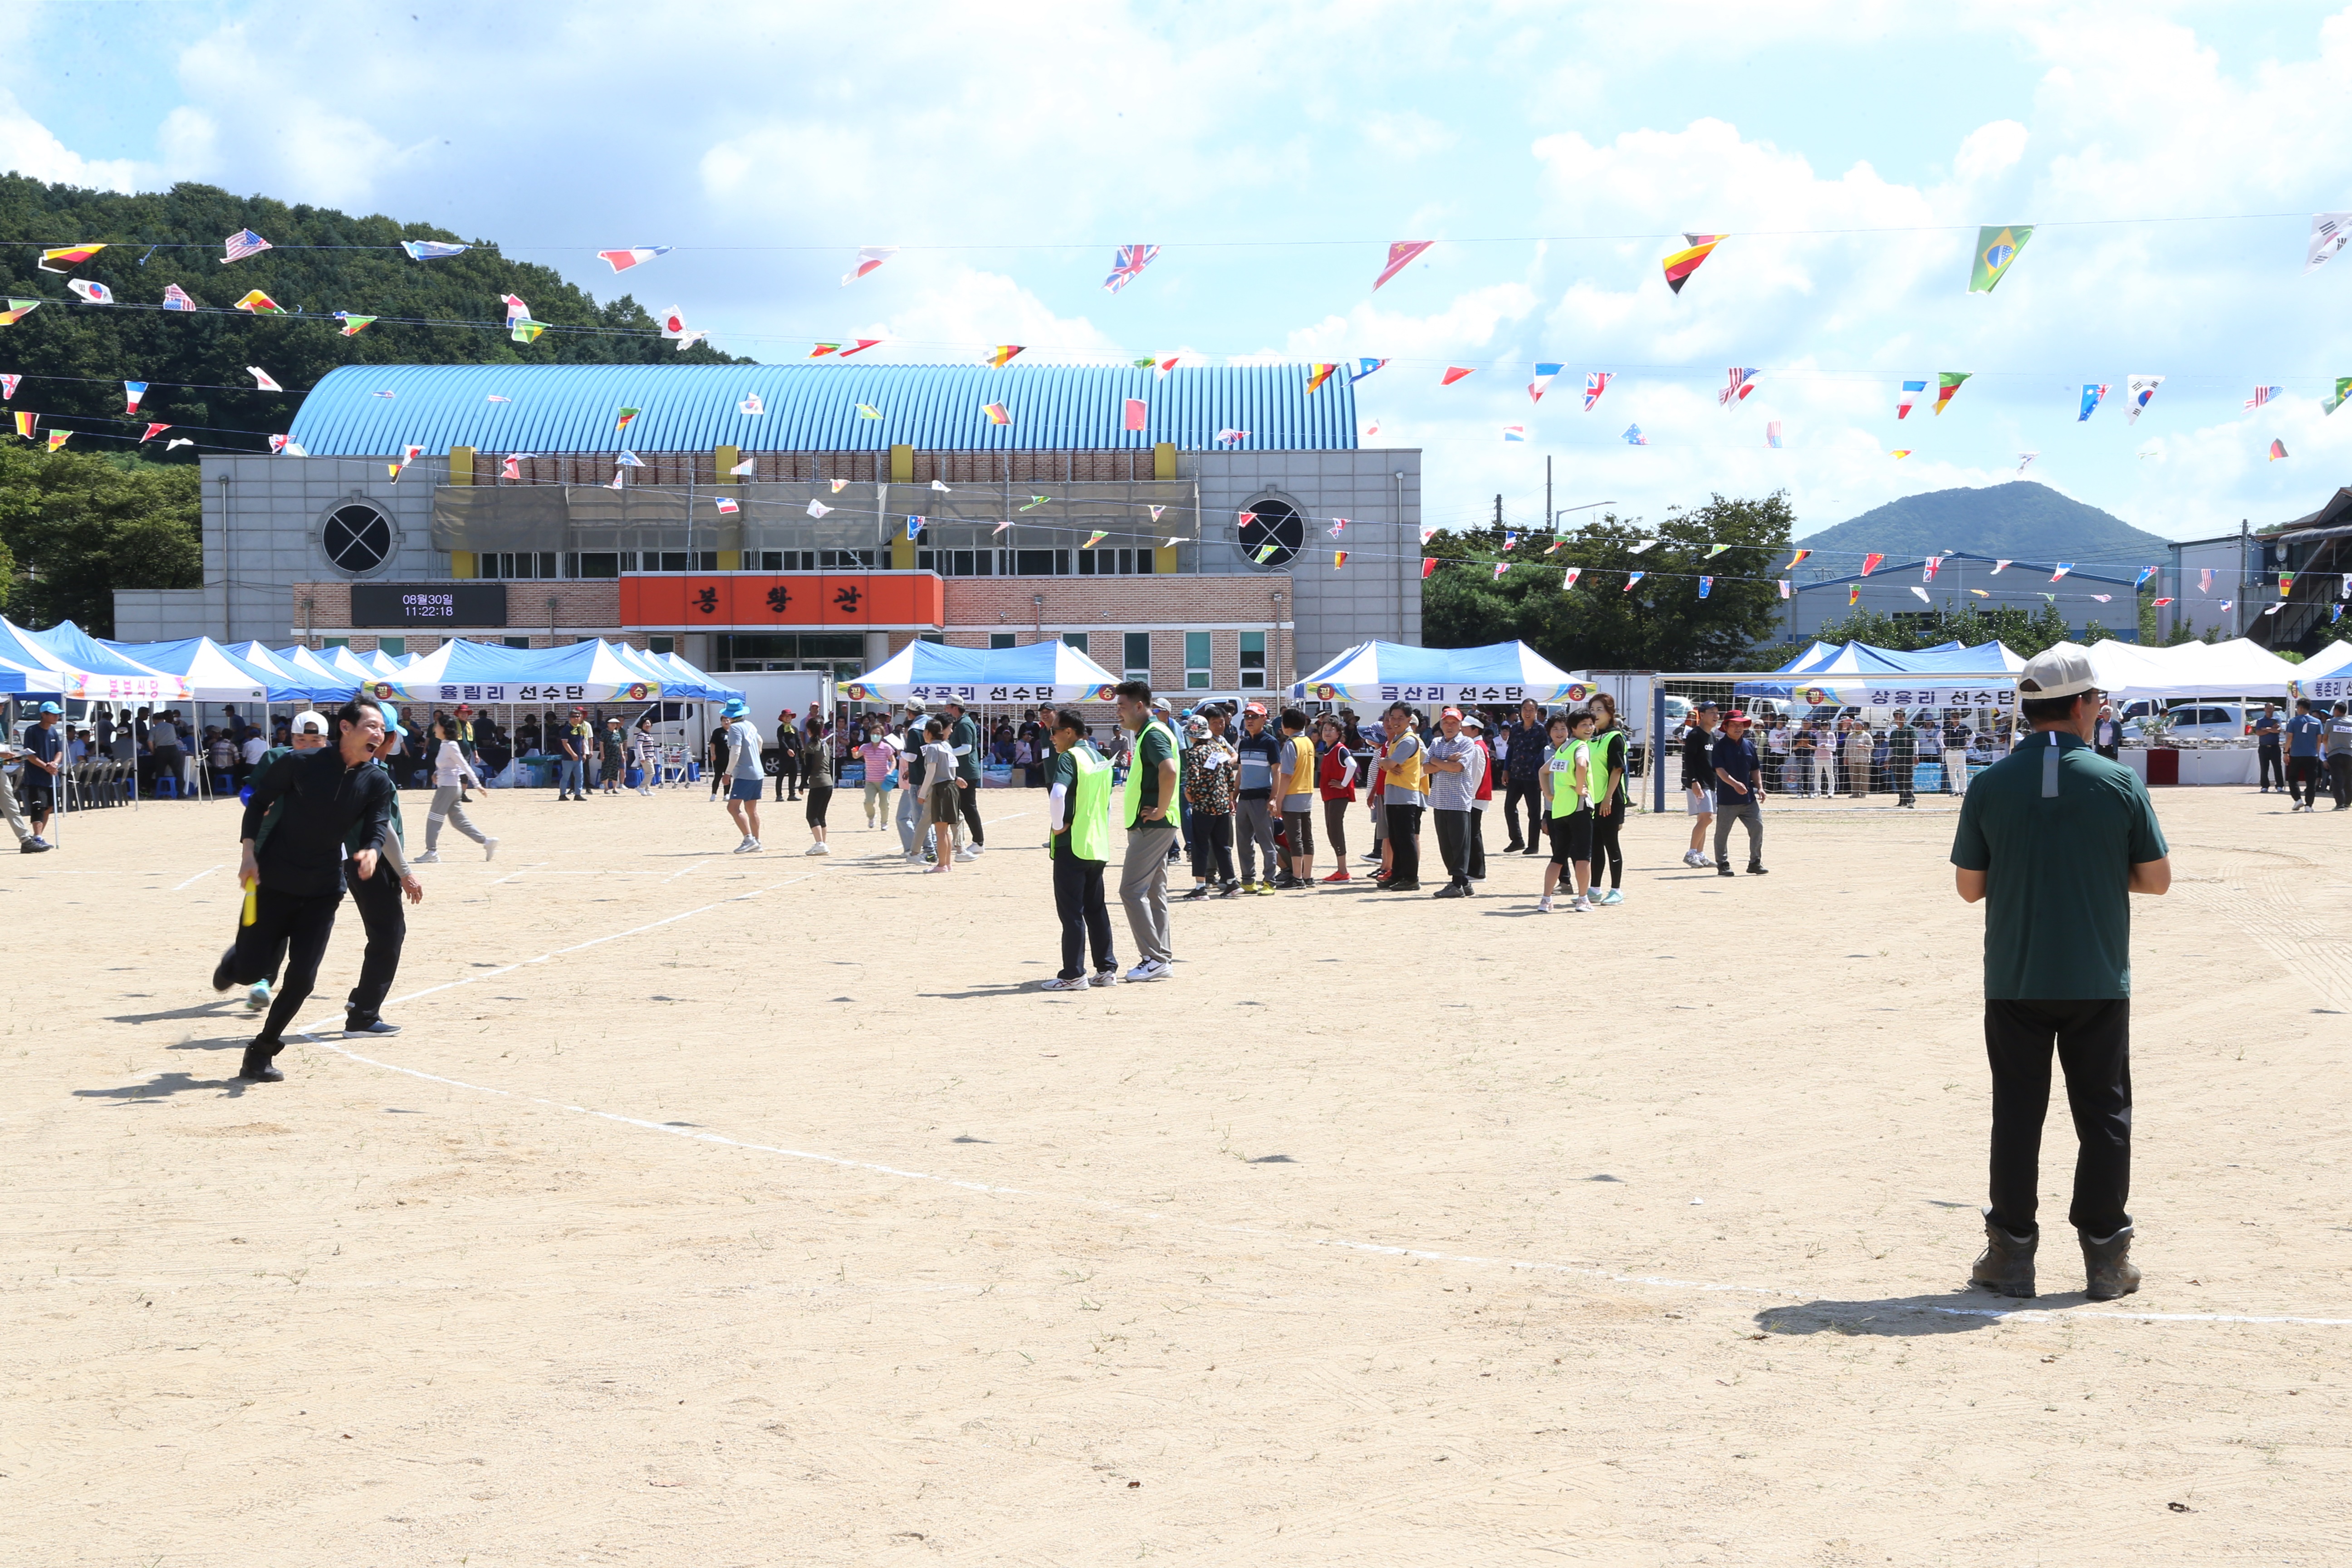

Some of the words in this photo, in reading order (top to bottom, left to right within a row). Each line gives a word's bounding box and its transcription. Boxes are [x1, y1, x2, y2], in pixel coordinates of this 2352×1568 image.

[403, 594, 453, 605] 08월30일
[692, 586, 862, 613] 봉황관
[405, 606, 453, 616] 11:22:18
[109, 679, 158, 698] 본부식당
[377, 686, 387, 697] 필
[440, 685, 504, 700] 율림리
[519, 686, 584, 700] 선수단
[633, 686, 644, 697] 승
[851, 687, 861, 698] 필
[912, 686, 975, 701] 상곡리
[990, 686, 1054, 701] 선수단
[1102, 687, 1113, 699] 승
[1320, 687, 1330, 698] 필
[1382, 686, 1444, 701] 금산리
[1459, 687, 1524, 701] 선수단
[1572, 687, 1583, 699] 승
[2315, 681, 2341, 697] 봉촌리
[1809, 691, 1819, 702] 필
[1872, 691, 1935, 705] 상용리
[1951, 691, 2015, 705] 선수단
